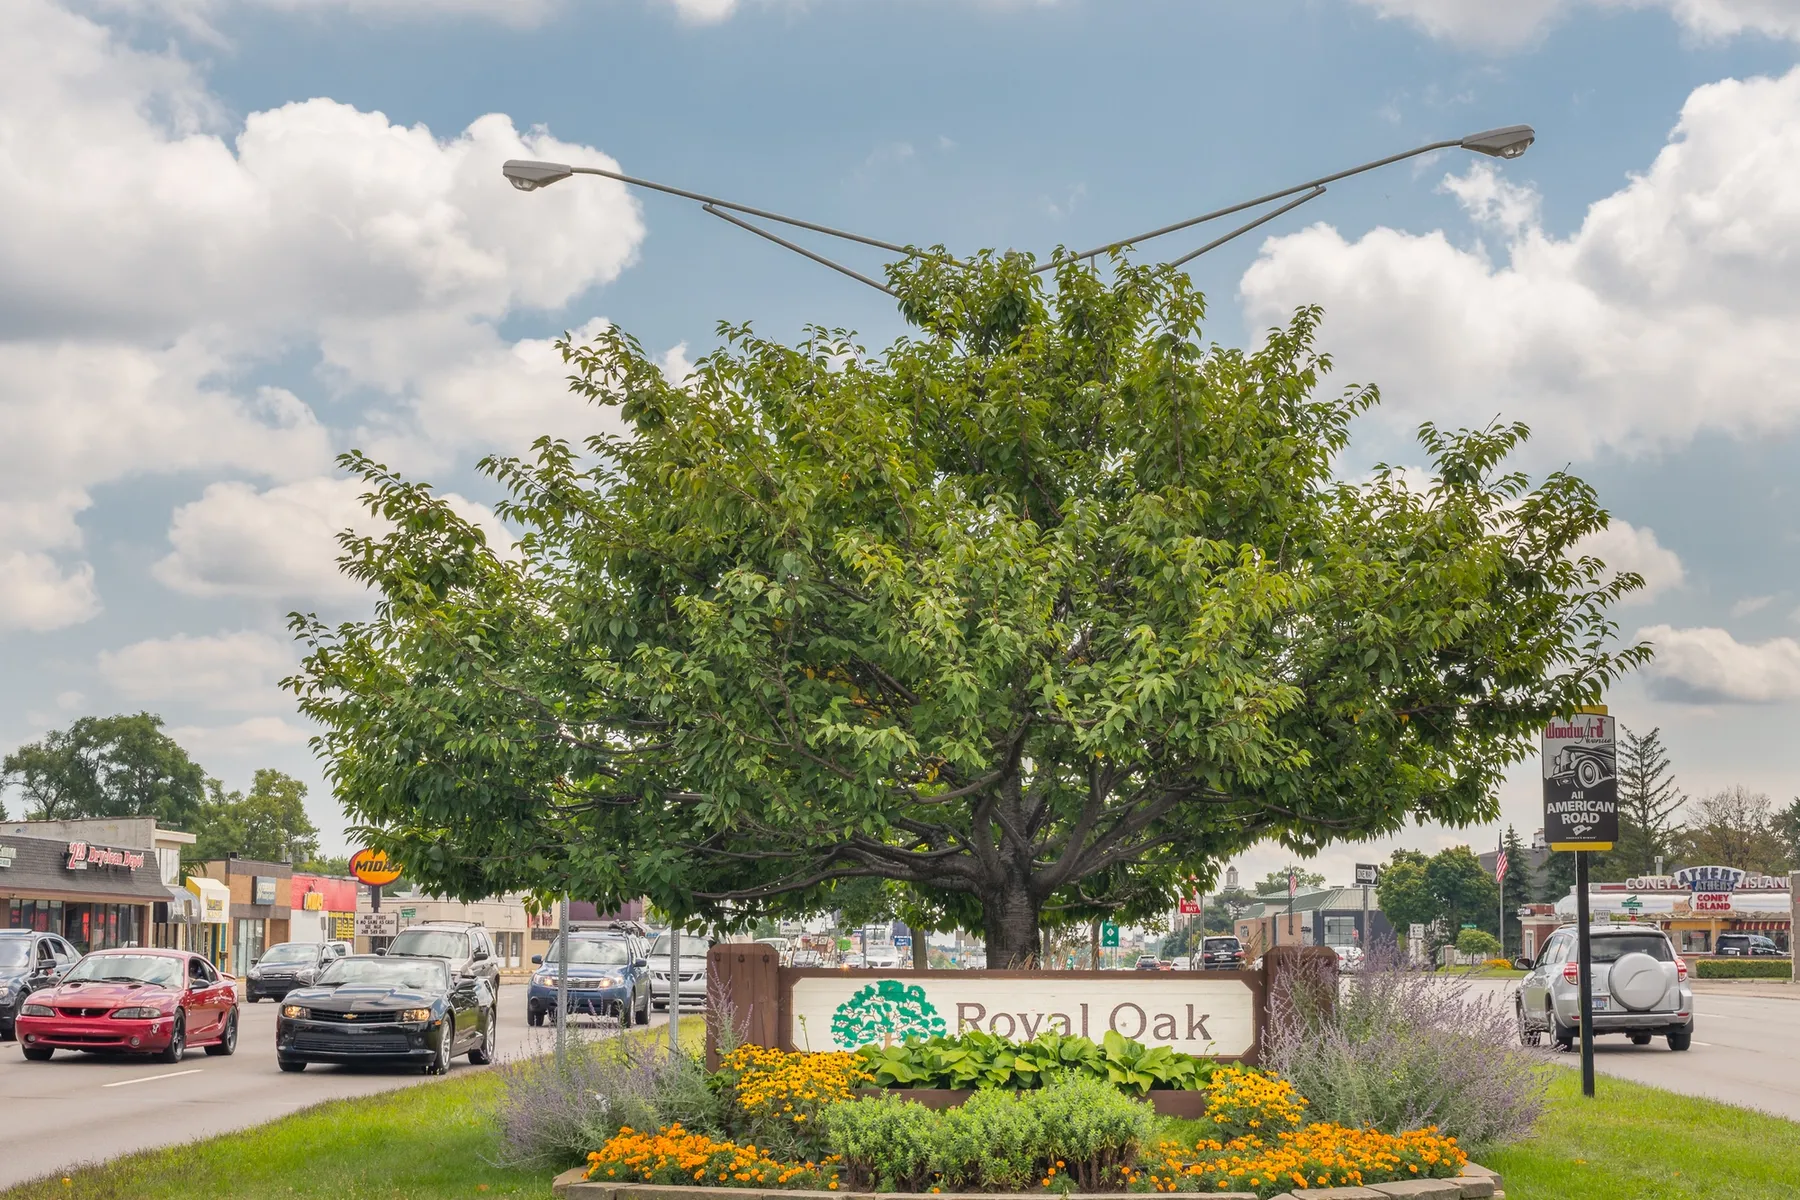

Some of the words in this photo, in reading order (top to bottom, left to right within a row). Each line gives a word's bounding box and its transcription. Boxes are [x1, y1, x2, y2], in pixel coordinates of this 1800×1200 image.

[1571, 791, 1584, 799] All
[1547, 800, 1615, 815] AMERICAN
[1561, 812, 1600, 825] ROAD
[123, 851, 144, 871] Depot
[1625, 877, 1673, 890] CONEY
[1697, 894, 1729, 902] CONEY
[956, 1002, 1089, 1042] Royal
[1109, 1002, 1212, 1041] Oak
